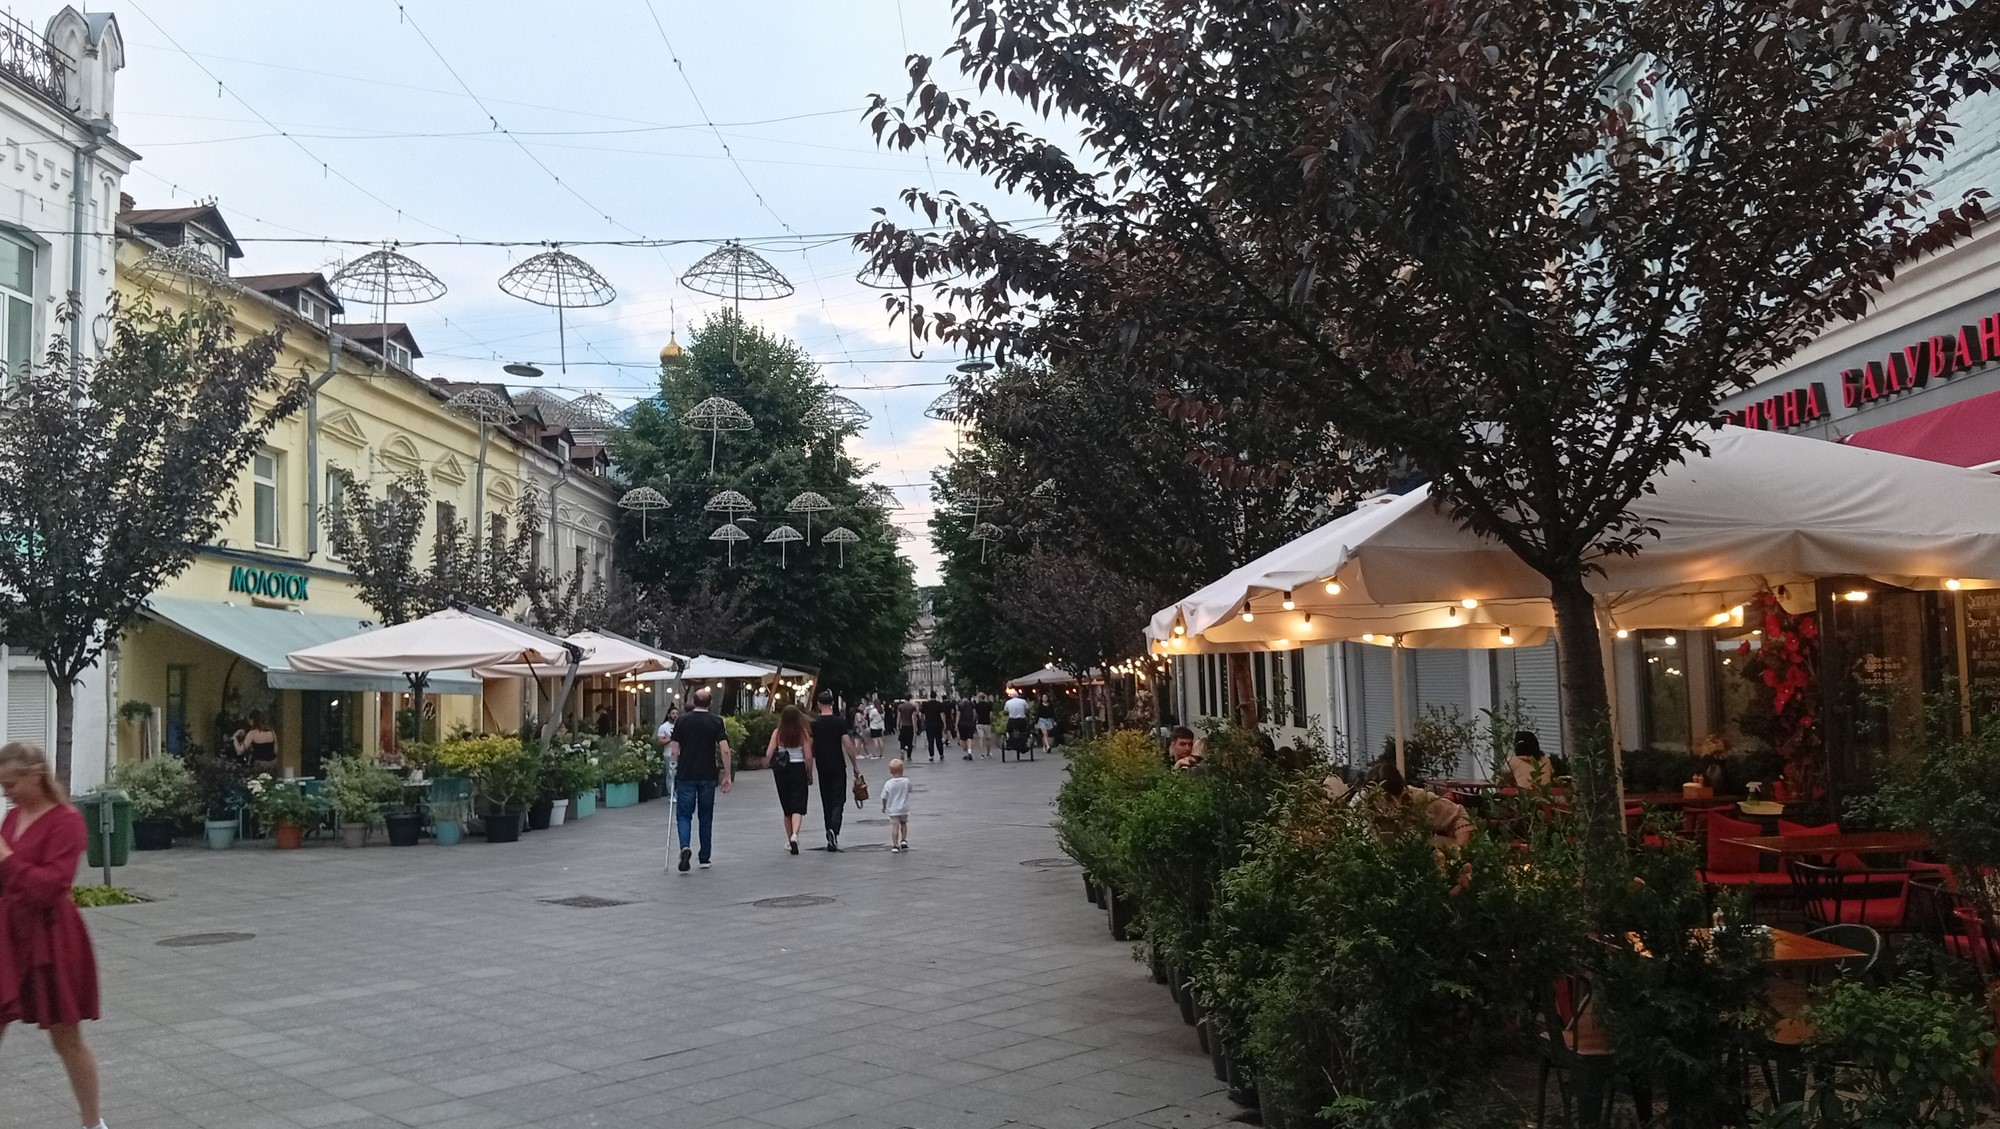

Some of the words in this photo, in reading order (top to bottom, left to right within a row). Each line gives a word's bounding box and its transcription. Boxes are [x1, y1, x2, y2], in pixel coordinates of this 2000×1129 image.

[1726, 381, 1829, 431] ИЧНА
[1839, 312, 2000, 409] БАЛУВАН
[229, 566, 309, 601] МОЛОТОК
